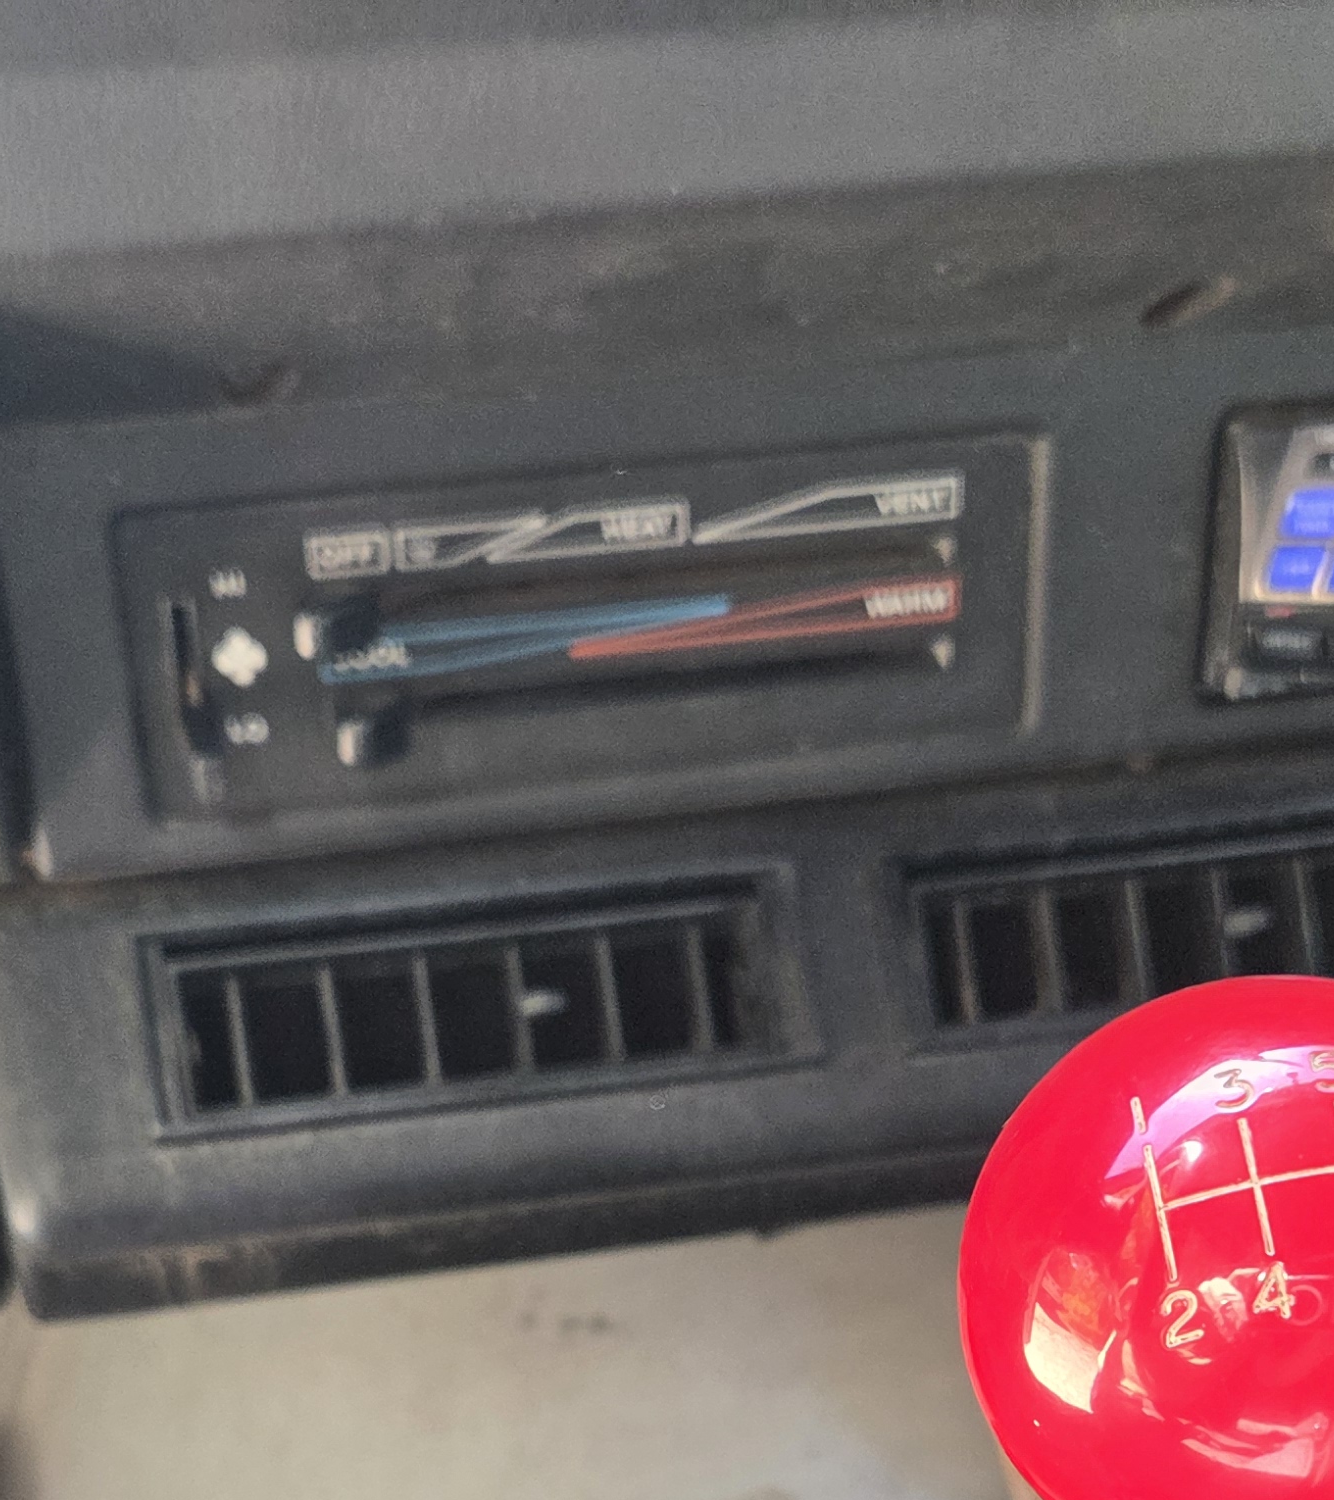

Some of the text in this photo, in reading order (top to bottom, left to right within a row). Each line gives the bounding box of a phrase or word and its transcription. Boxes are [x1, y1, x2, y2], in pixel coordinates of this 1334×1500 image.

[874, 486, 949, 515] VENT
[865, 587, 948, 619] WARM
[1213, 1068, 1256, 1110] 3
[1161, 1288, 1206, 1349] 2
[1252, 1261, 1296, 1320] 4
